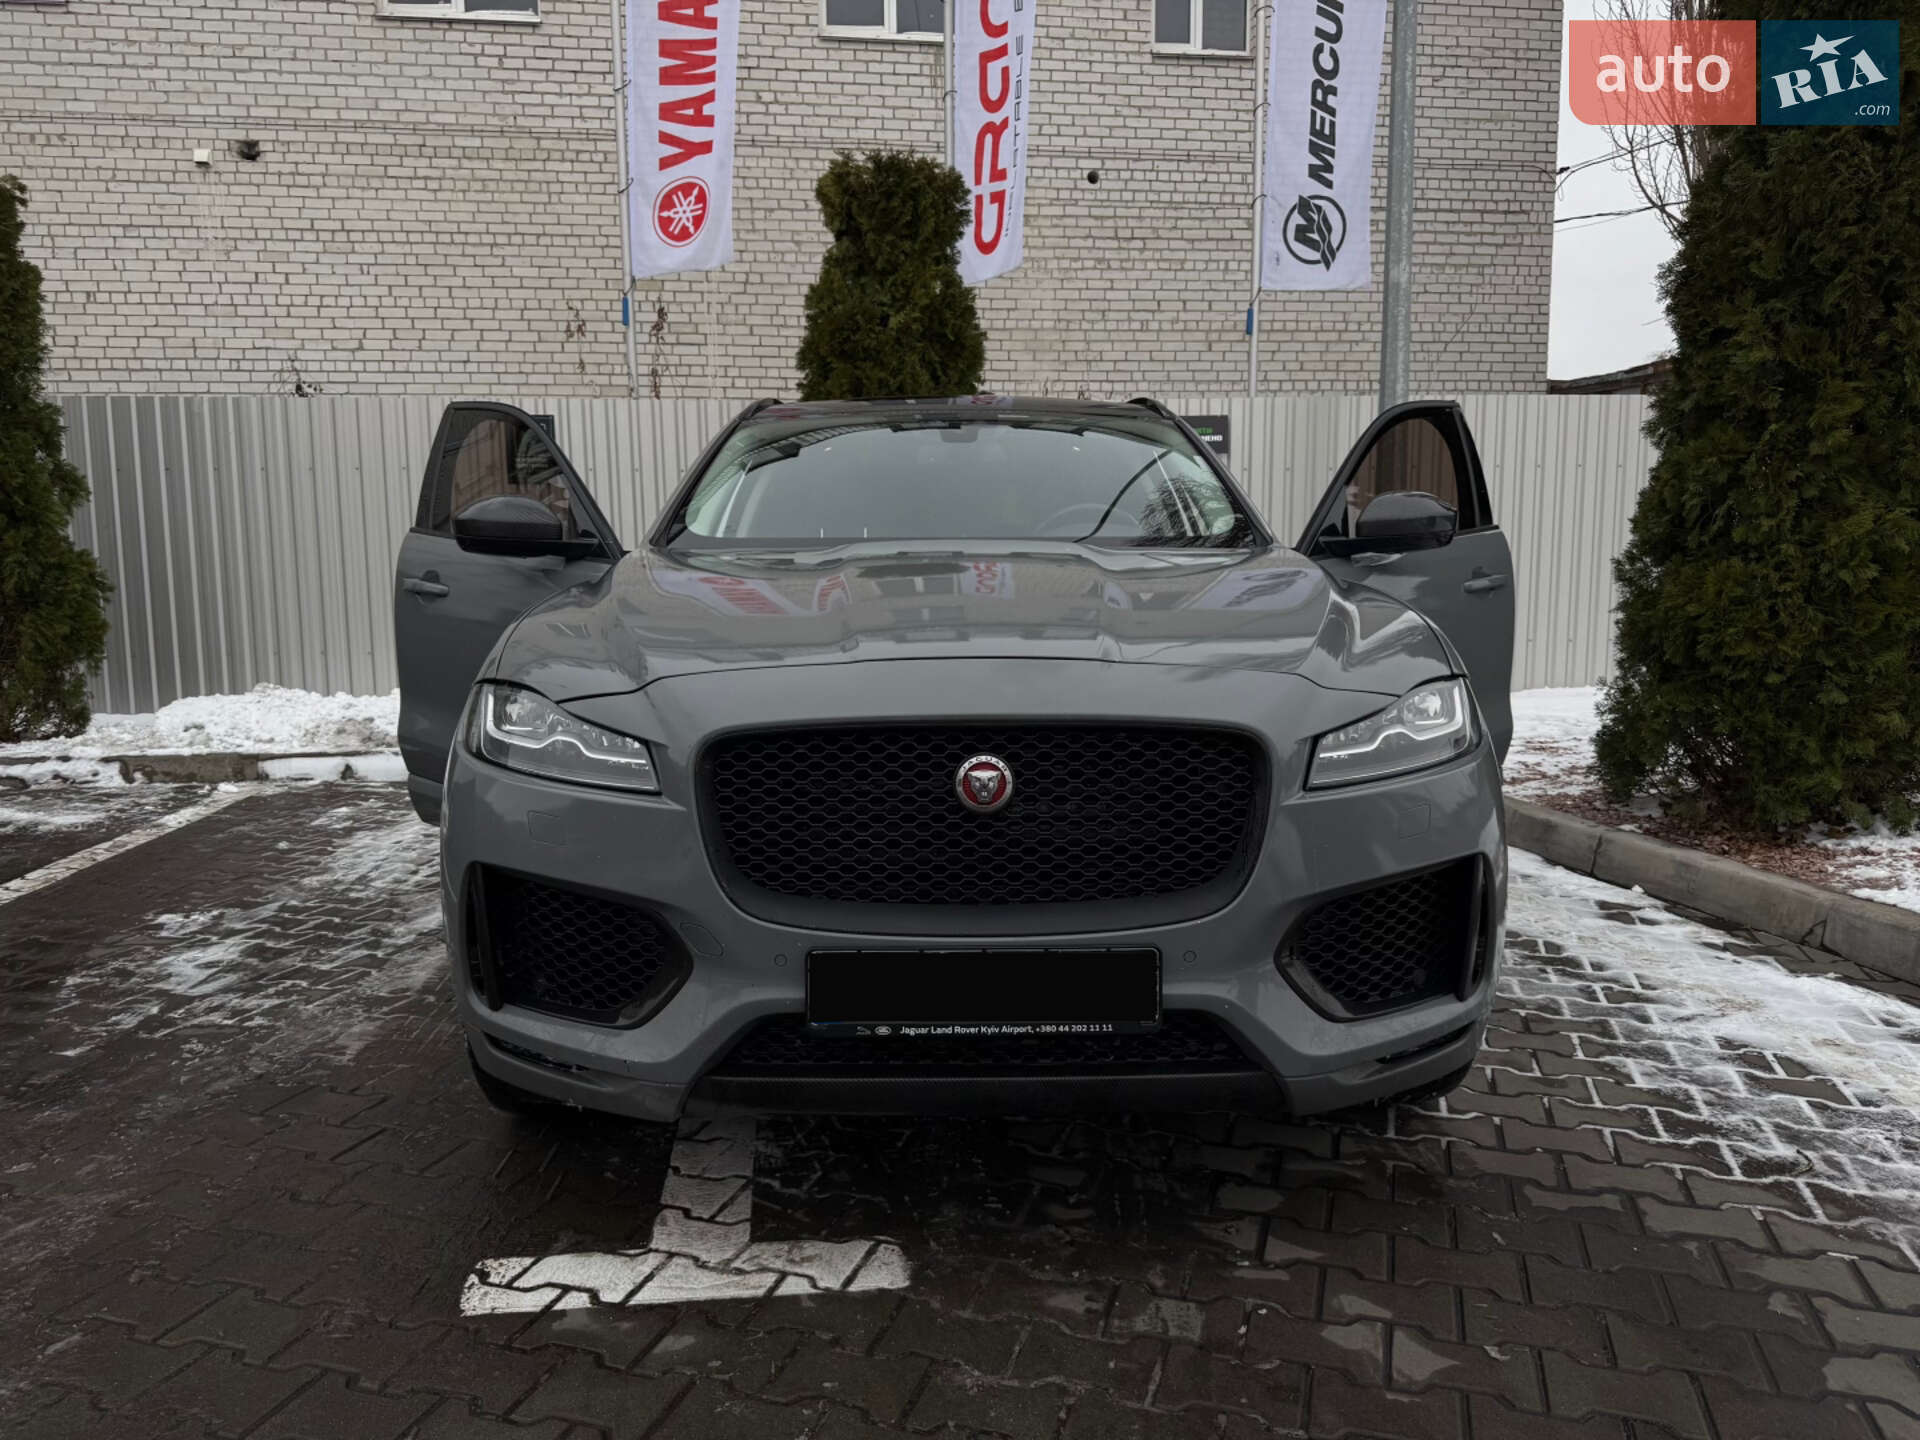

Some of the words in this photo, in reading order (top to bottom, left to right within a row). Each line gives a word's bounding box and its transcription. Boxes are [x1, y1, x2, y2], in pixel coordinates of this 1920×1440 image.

[658, 0, 719, 172] YAMA
[900, 1026, 929, 1037] Jaguar
[931, 1025, 953, 1034] Land
[954, 1025, 979, 1034] Rover
[981, 1025, 1000, 1036] Kyiv
[1001, 1024, 1034, 1036] Airport,
[1036, 1024, 1057, 1033] +380
[1058, 1024, 1070, 1033] 44
[1071, 1024, 1088, 1032] 202
[1089, 1024, 1100, 1032] 11
[1102, 1024, 1113, 1032] 11
